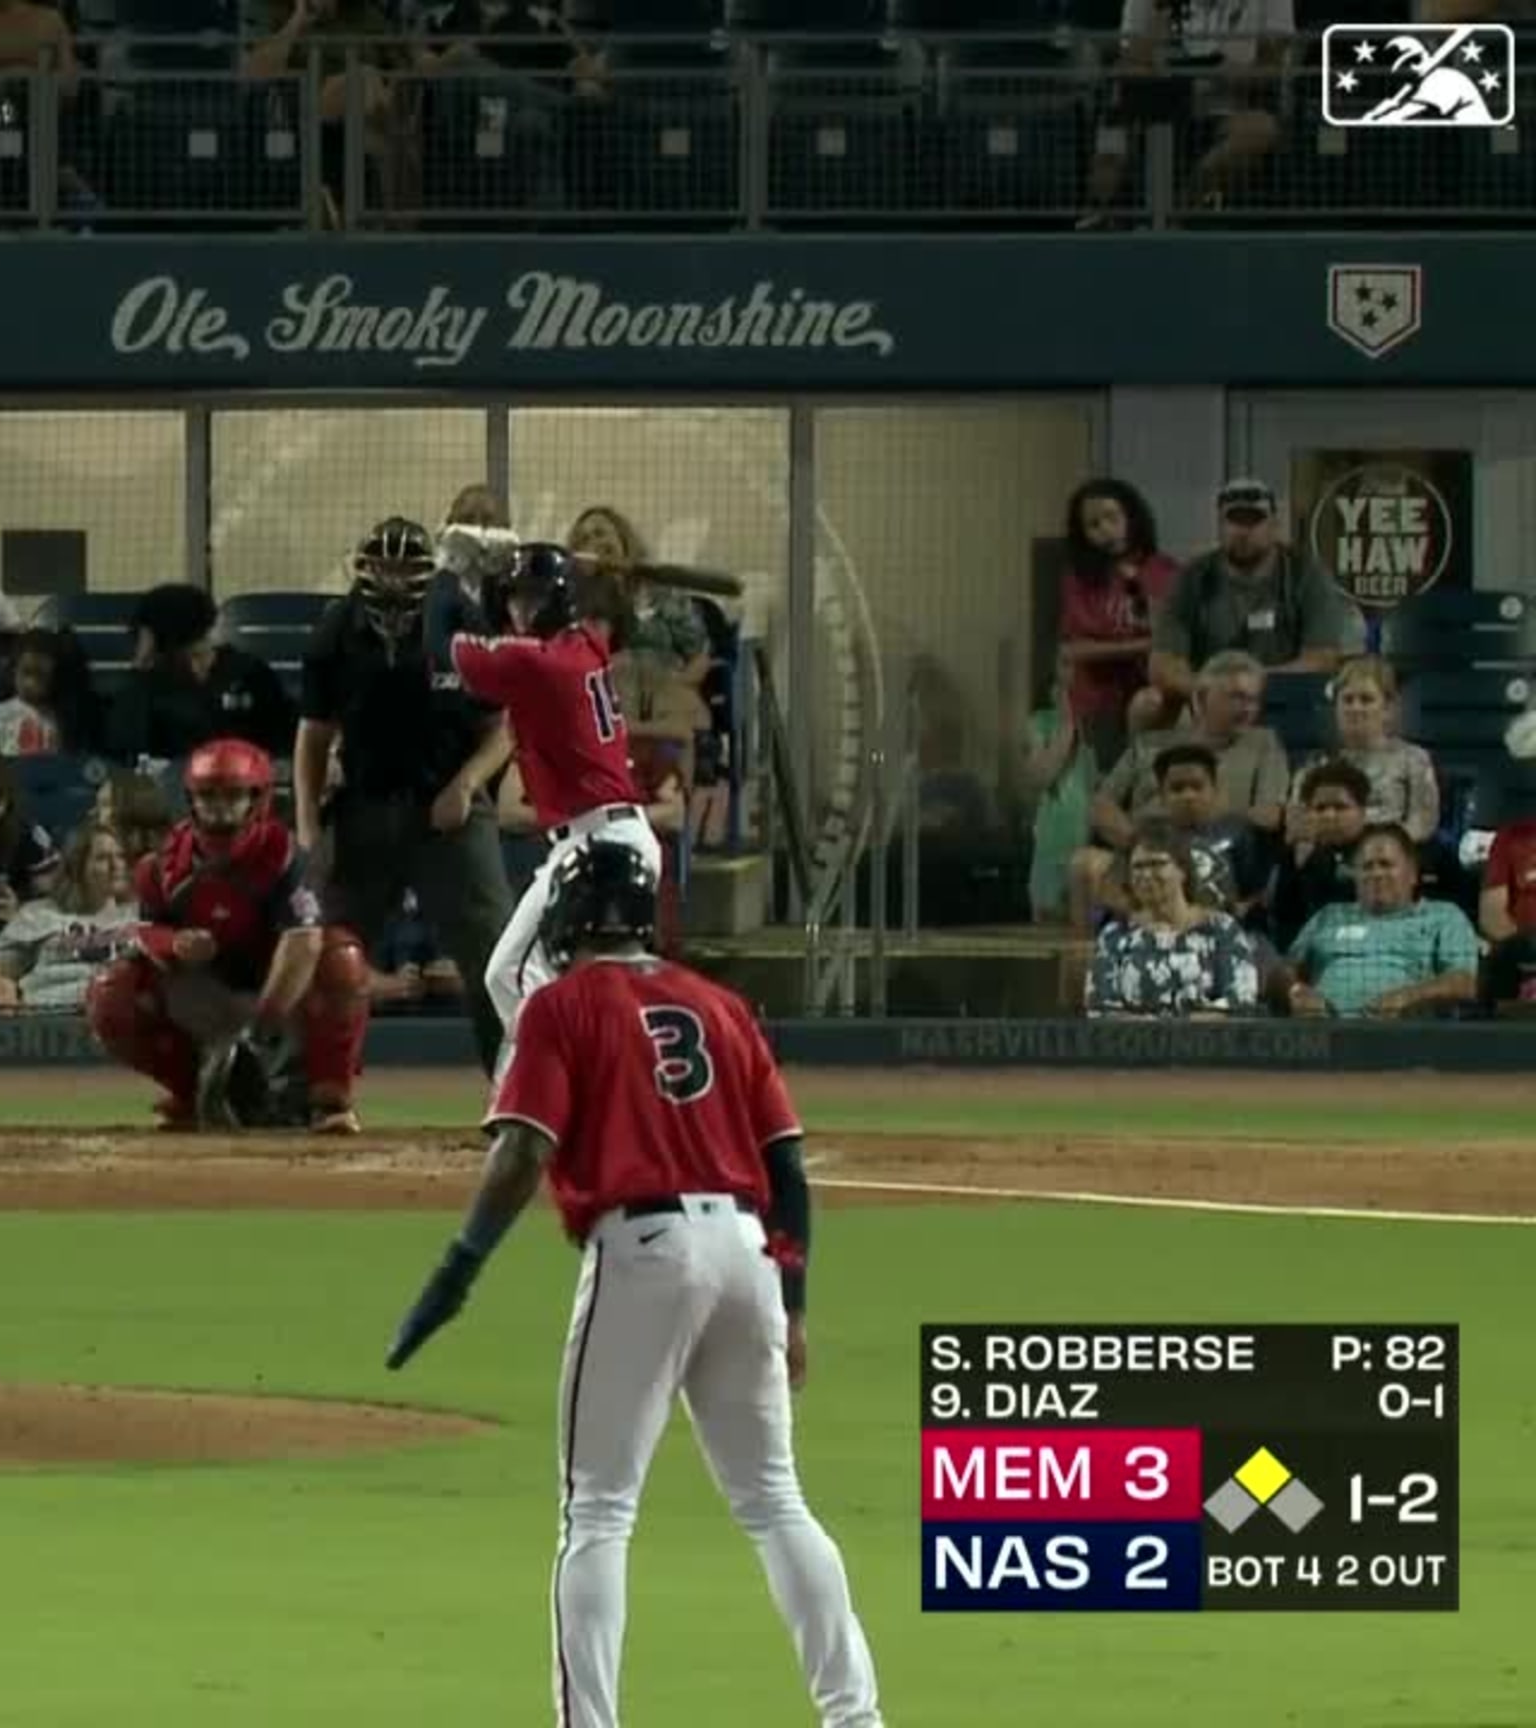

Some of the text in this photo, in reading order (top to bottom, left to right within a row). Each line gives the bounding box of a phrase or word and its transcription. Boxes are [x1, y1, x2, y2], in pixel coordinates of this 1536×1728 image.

[265, 273, 487, 367] Smoky
[506, 271, 894, 357] Moonshine
[1336, 496, 1428, 533] YEE
[1337, 536, 1429, 574] HAW
[638, 1003, 715, 1105] 3
